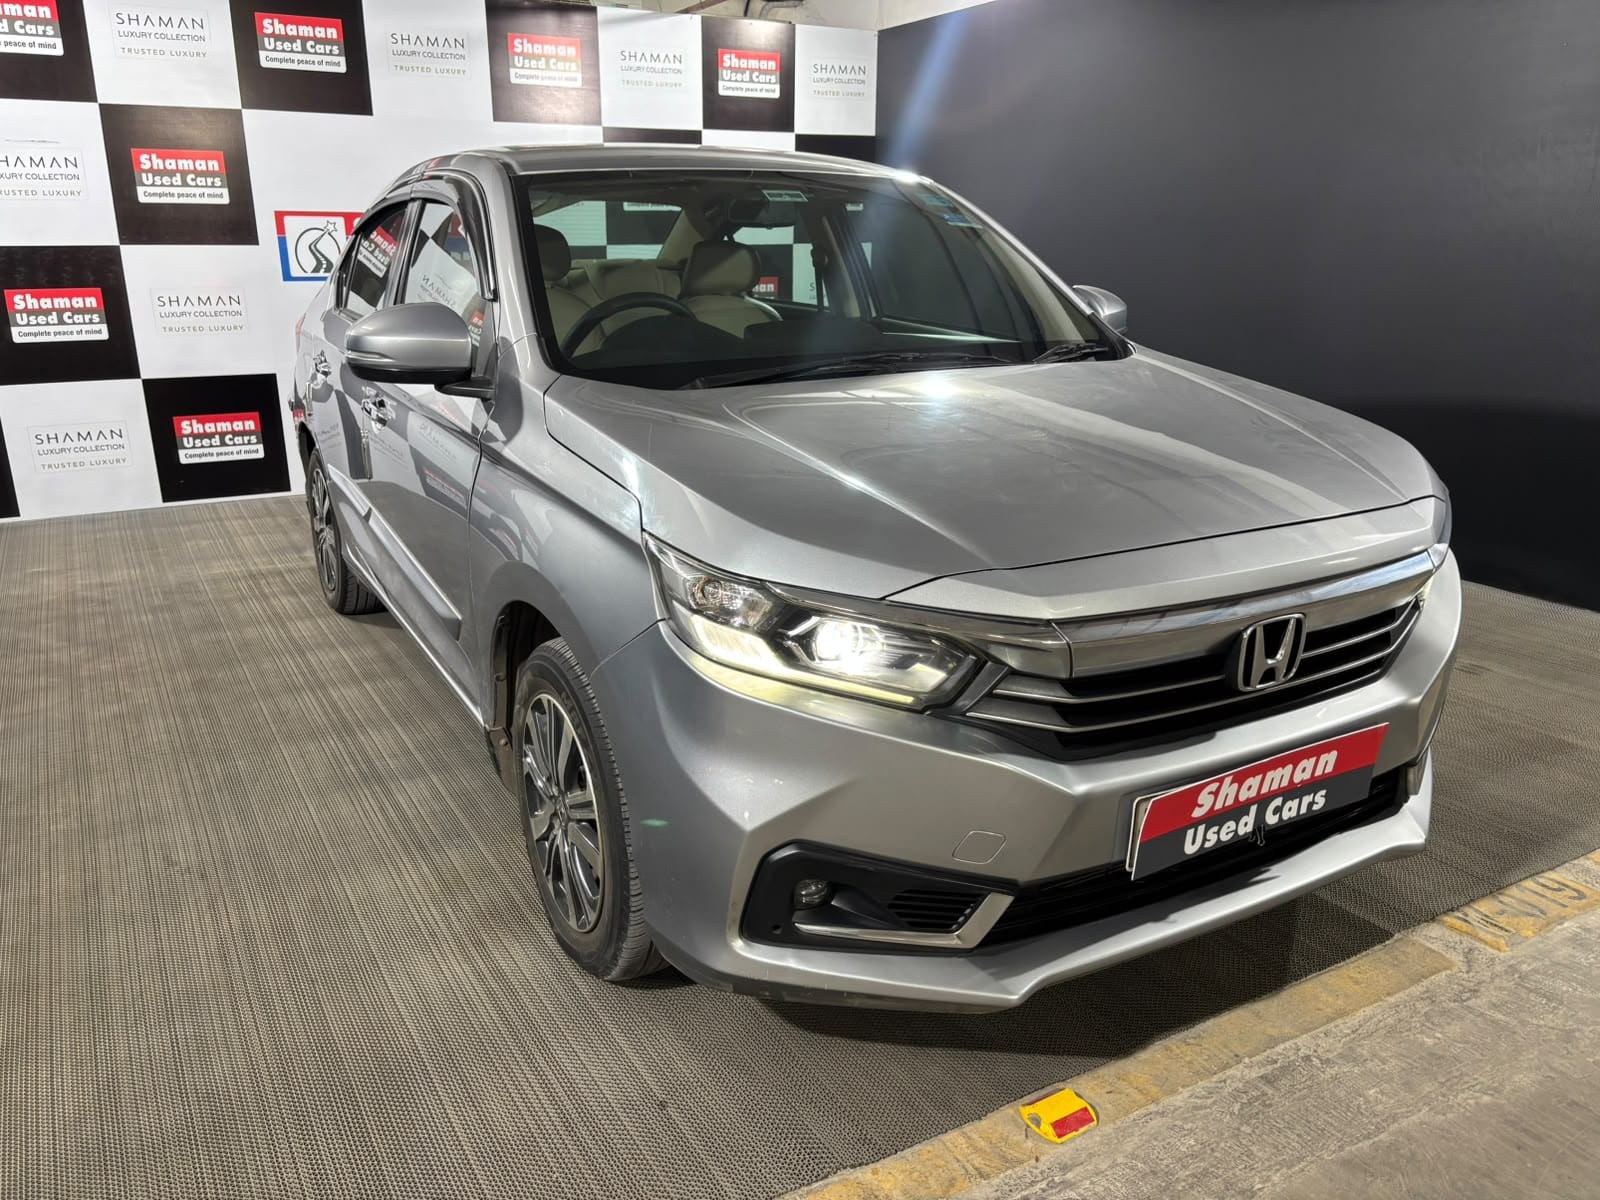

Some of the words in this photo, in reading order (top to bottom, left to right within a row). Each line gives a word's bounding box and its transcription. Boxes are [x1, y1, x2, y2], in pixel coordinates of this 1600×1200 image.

[14, 20, 54, 36] Cars
[115, 12, 204, 30] SHAMAN
[262, 18, 338, 39] Shaman
[117, 30, 152, 39] LUXURY
[153, 32, 206, 42] COLLECTION
[390, 32, 465, 49] SHAMAN
[4, 40, 26, 48] peace
[38, 42, 57, 50] mind
[263, 37, 302, 52] Used
[306, 40, 340, 55] Cars
[513, 38, 576, 57] Shaman
[121, 47, 166, 56] TRUSTED
[169, 50, 207, 58] LUXURY
[392, 49, 421, 57] LUXURY
[422, 51, 466, 60] COLLECTION
[620, 50, 682, 65] SHAMAN
[265, 55, 295, 65] Complete
[297, 58, 316, 67] peace
[325, 60, 341, 68] mind
[514, 56, 546, 69] Used
[549, 58, 577, 71] Cars
[723, 53, 776, 71] Shaman
[394, 64, 432, 73] TRUSTED
[435, 67, 466, 76] LUXURY
[812, 63, 866, 75] SHAMAN
[722, 69, 750, 82] Used
[752, 71, 776, 84] Cars
[722, 84, 744, 92] Complete
[0, 155, 78, 169] HAMAN
[139, 153, 219, 171] Shaman
[25, 173, 80, 181] COLLECTION
[141, 172, 182, 186] Used
[186, 174, 222, 187] Cars
[42, 189, 81, 197] LUXURY
[143, 190, 175, 199] Complete
[13, 293, 97, 310] Shaman
[157, 295, 241, 308] SHAMAN
[15, 311, 58, 326] Used
[62, 311, 100, 324] Cars
[159, 311, 192, 319] LUXURY
[193, 310, 242, 318] COLLECTION
[18, 330, 52, 339] Complete
[84, 328, 102, 336] mind
[162, 325, 205, 333] TRUSTED
[208, 324, 243, 332] LUXURY
[181, 419, 255, 435] Shaman
[34, 428, 123, 446] SHAMAN
[182, 435, 221, 449] Used
[224, 433, 258, 446] Cars
[37, 447, 72, 457] LUXURY
[73, 443, 125, 454] COLLECTION
[184, 452, 215, 460] Complete
[41, 461, 86, 470] TRUSTED
[89, 457, 127, 467] LUXURY
[1190, 749, 1338, 819] Shaman
[1183, 804, 1258, 855] Used
[1264, 789, 1327, 825] Cars
